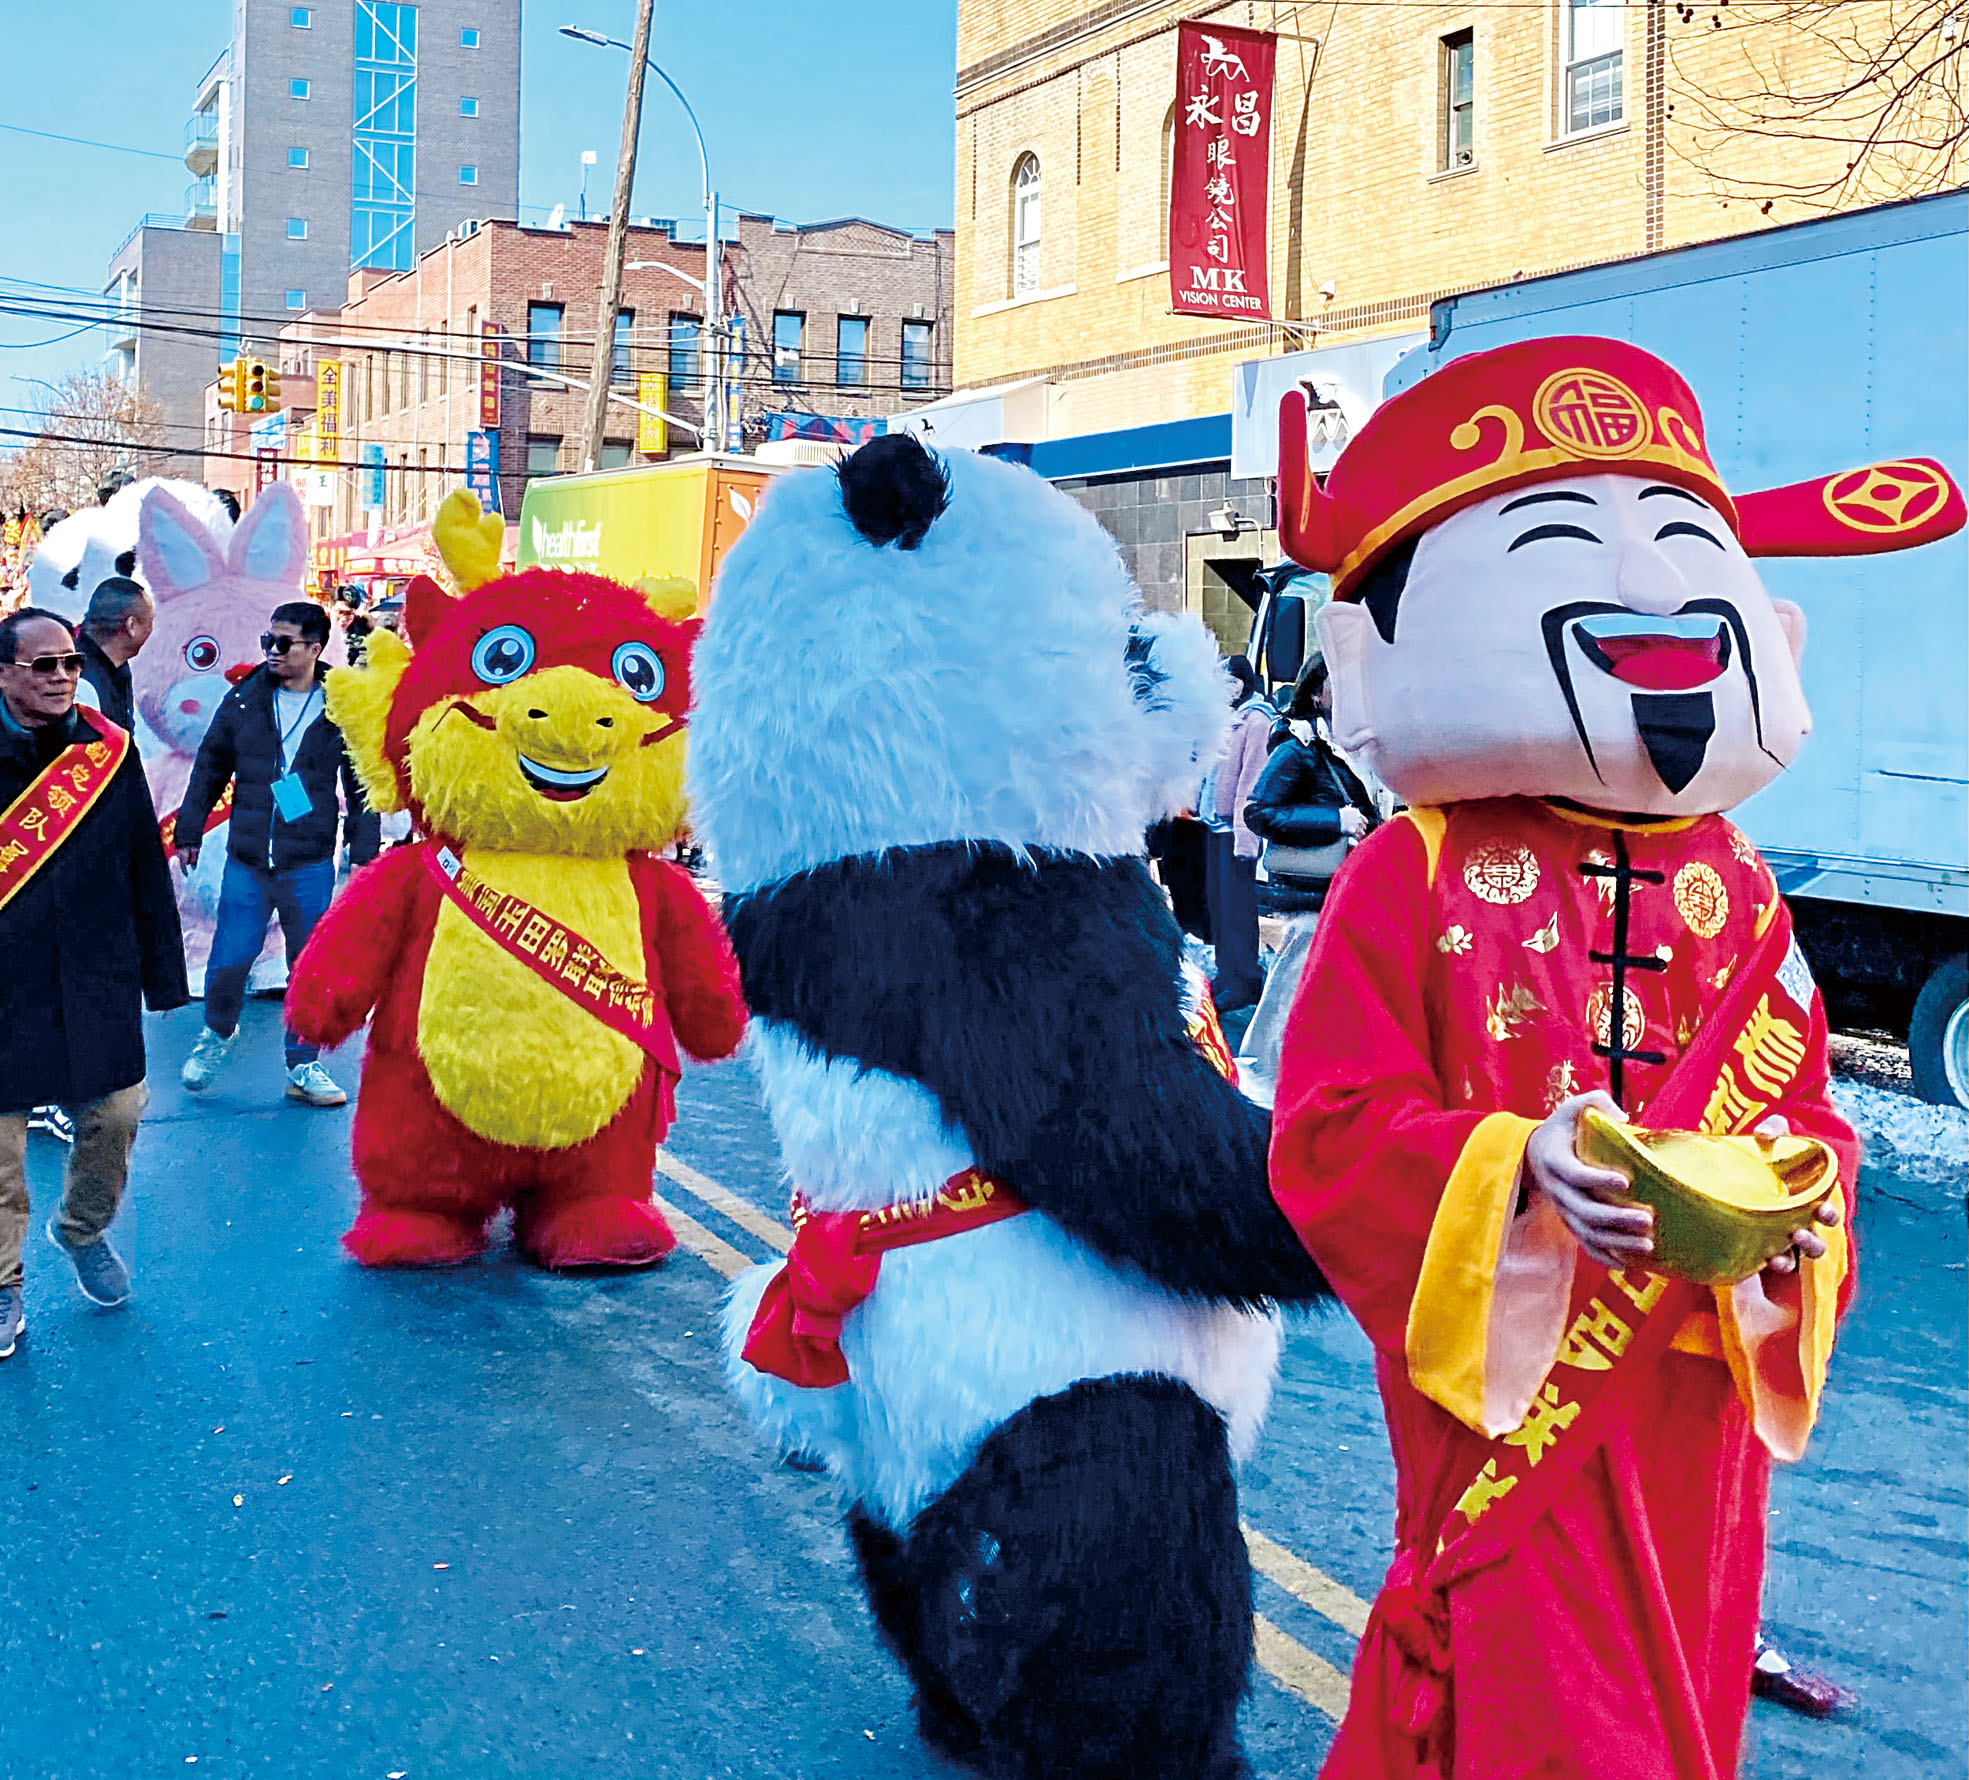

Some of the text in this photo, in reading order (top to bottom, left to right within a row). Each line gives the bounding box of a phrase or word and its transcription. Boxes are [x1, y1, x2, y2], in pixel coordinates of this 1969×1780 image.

[1184, 84, 1261, 137] 永昌
[1203, 133, 1237, 264] 眼鏡公司
[1179, 289, 1262, 311] VISION CENTER
[1190, 264, 1248, 294] MK
[320, 365, 338, 457] 全美福利
[541, 520, 601, 560] healthfirst
